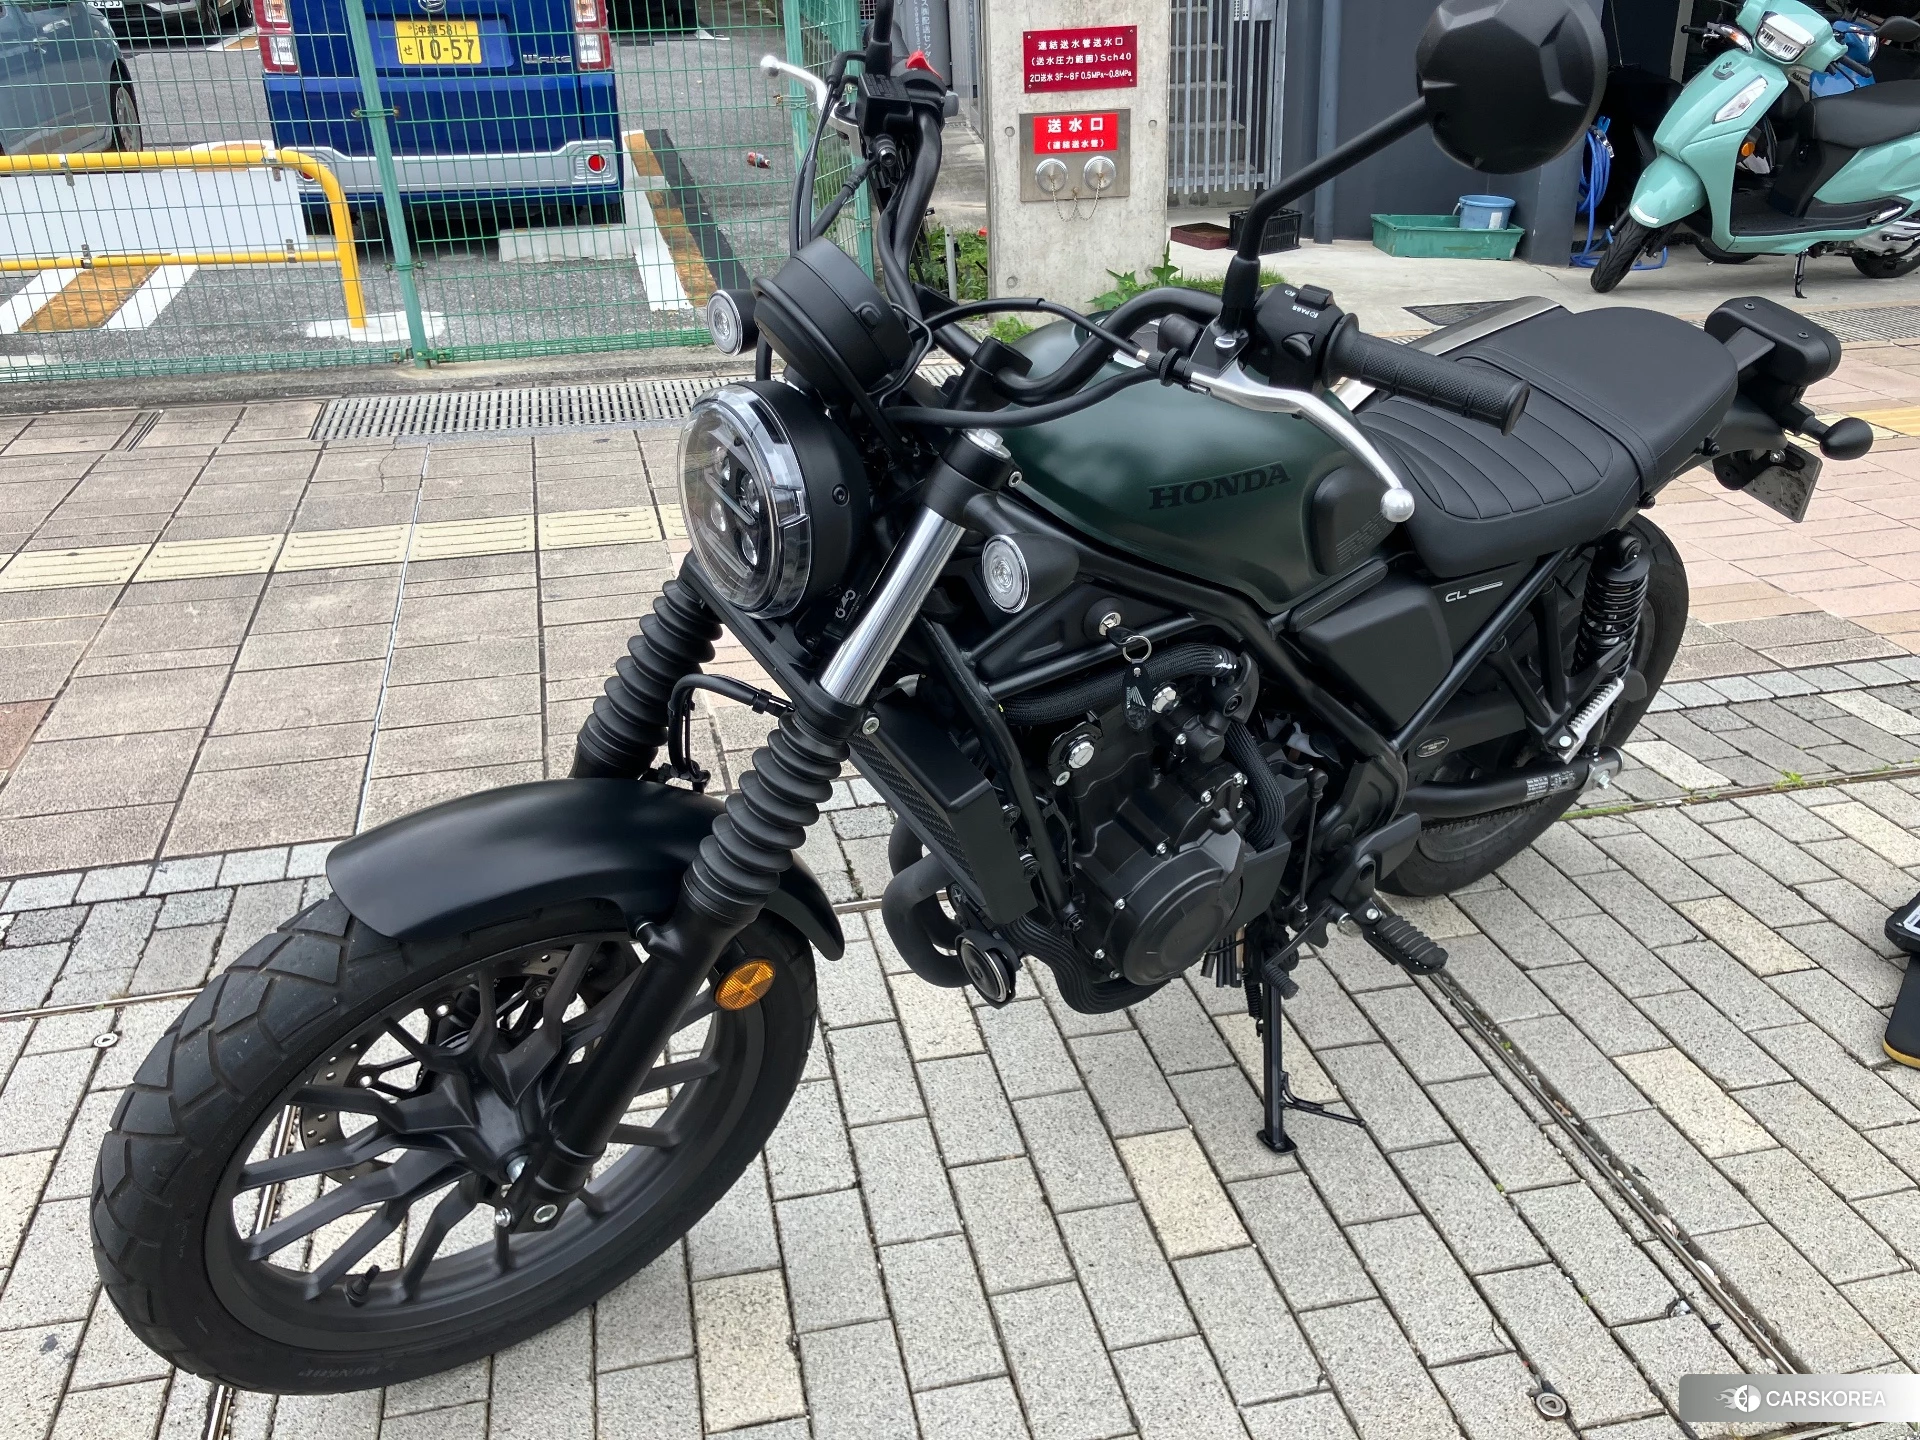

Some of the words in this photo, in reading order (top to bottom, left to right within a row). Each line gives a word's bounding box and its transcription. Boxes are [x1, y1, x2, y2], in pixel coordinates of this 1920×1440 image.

[419, 39, 474, 60] 10-57
[1038, 37, 1123, 50] 連結送水管送水口
[1047, 117, 1104, 133] 送水口
[1148, 461, 1291, 510] HONDA
[1445, 591, 1467, 602] CL
